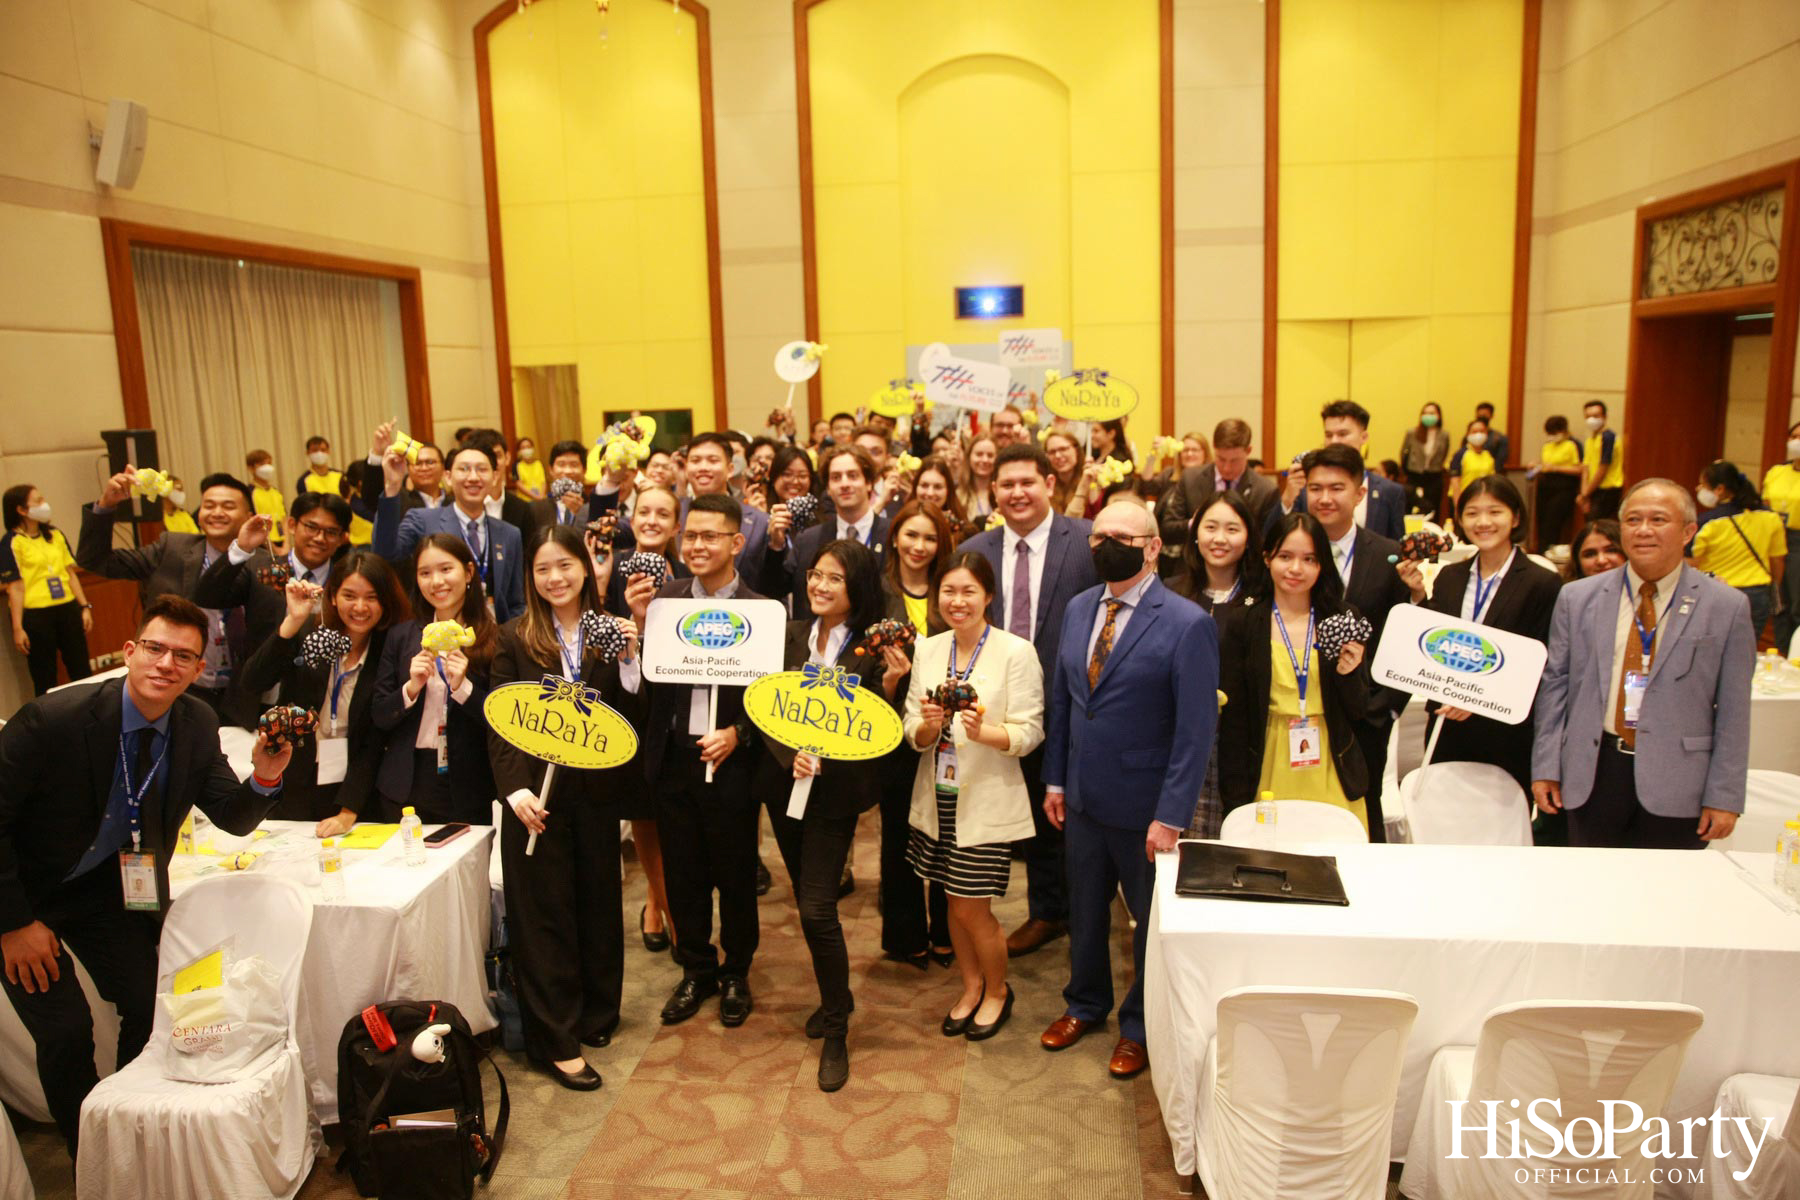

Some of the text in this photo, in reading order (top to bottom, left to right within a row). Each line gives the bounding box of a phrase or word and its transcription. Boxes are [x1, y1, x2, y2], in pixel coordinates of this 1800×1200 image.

[1060, 389, 1121, 408] NaRaYa
[694, 622, 733, 637] APEC
[682, 655, 741, 666] Asia-Pacific
[1438, 639, 1483, 663] APEC
[655, 665, 768, 679] Economic Cooperation
[1418, 668, 1485, 695] Asia-Pacific
[1385, 669, 1512, 715] Economic Cooperation
[770, 688, 873, 742] NaRaYa
[510, 699, 608, 753] NaRaYa
[172, 1023, 232, 1038] CENTARA
